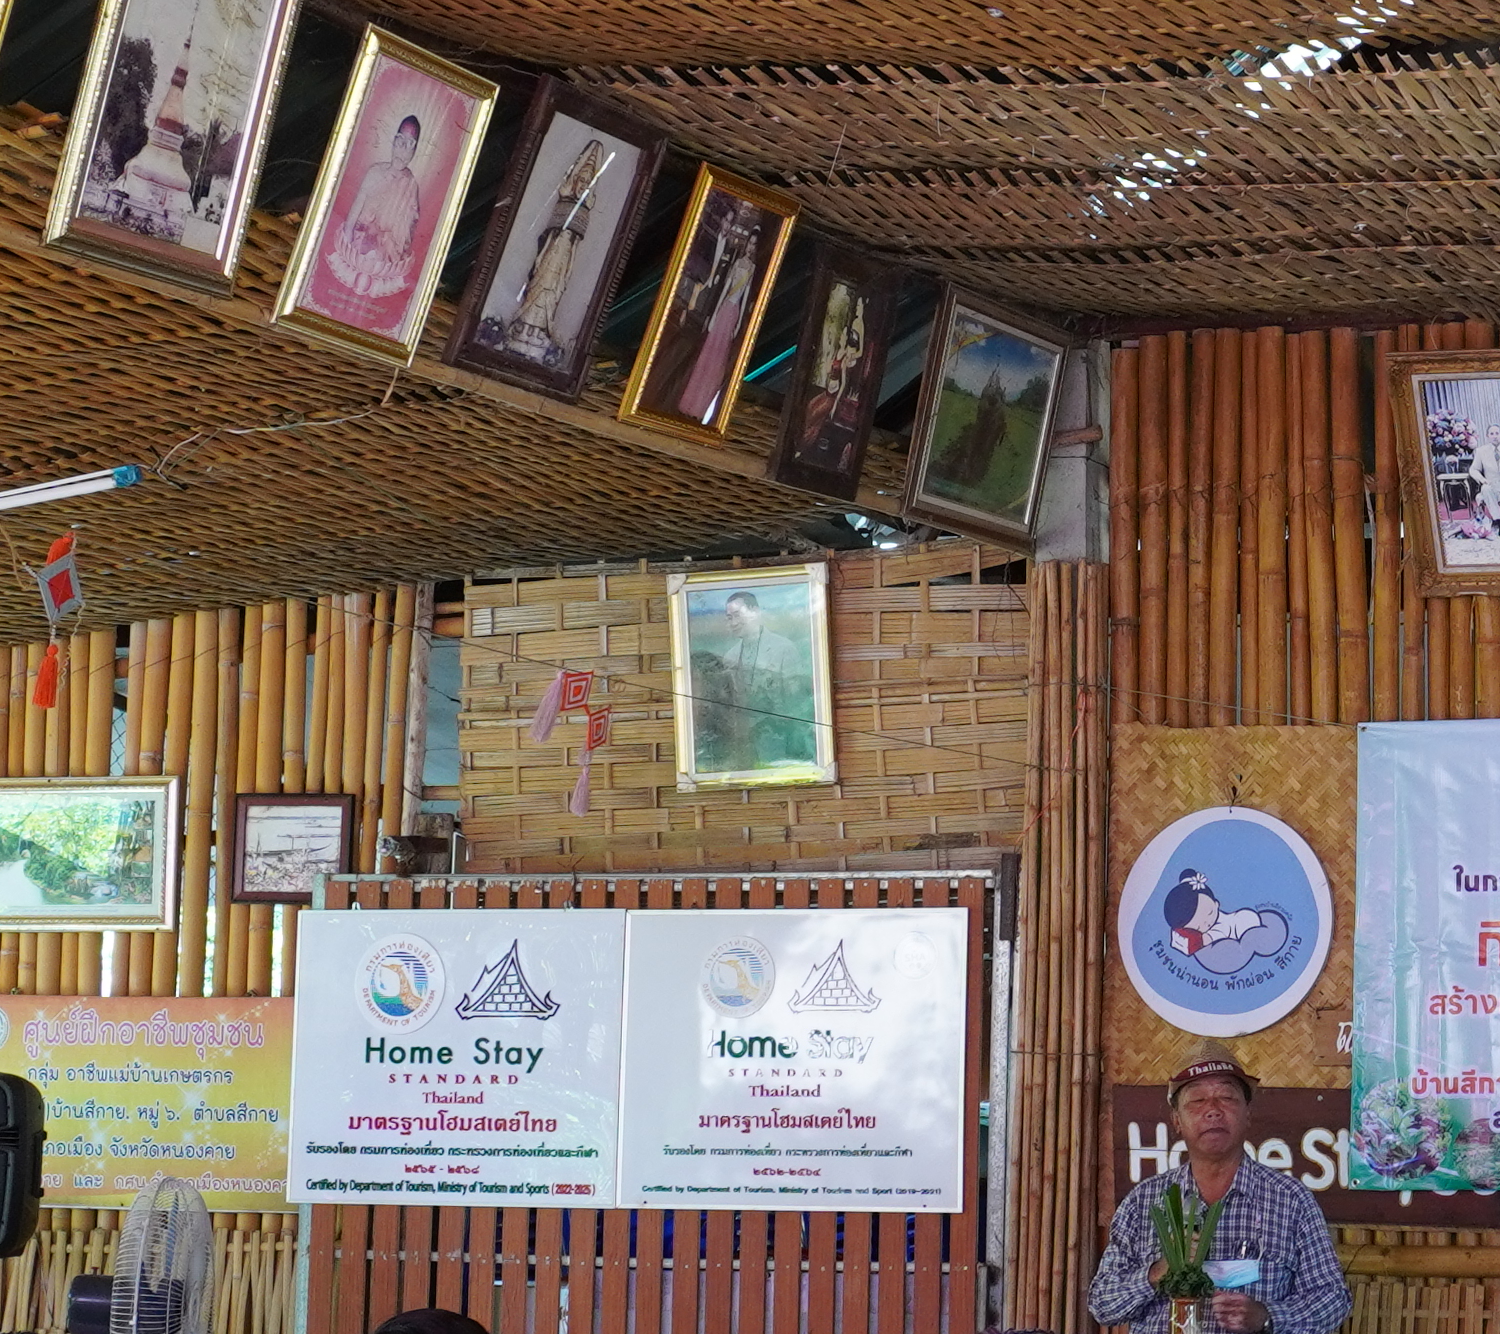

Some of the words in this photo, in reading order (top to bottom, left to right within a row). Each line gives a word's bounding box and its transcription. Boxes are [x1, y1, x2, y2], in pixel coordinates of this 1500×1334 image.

[1149, 939, 1219, 991] ชุมชนน่านอน
[1225, 971, 1275, 991] พักผ่อน
[1276, 935, 1303, 970] สีกาย
[24, 1008, 264, 1060] ศูนย์ฝึกอาชีพชุมชน
[365, 1037, 454, 1065] Home
[473, 1037, 545, 1073] Stay
[707, 1029, 798, 1059] Home
[806, 1029, 875, 1065] Stay
[28, 1063, 59, 1089] กลุ่ม
[66, 1062, 234, 1085] อาชีพแม่บ้านเกษตรกร
[389, 1073, 520, 1085] STANDARD
[728, 1067, 844, 1078] STANDARD
[422, 1091, 484, 1105] Thailand
[748, 1083, 822, 1098] Thailand
[137, 1101, 160, 1128] หมู่
[194, 1100, 279, 1123] ตำบลสีกาย
[348, 1110, 558, 1136] มาตรฐานโฮมสเตย์ไทย
[698, 1108, 877, 1134] มาตรฐานโฮมสเตย์ไทย
[110, 1136, 235, 1160] จังหวัดหนองคาย
[74, 1173, 104, 1188] และ
[306, 1179, 338, 1192] Certified
[339, 1179, 348, 1194] by
[350, 1180, 394, 1195] Department
[395, 1180, 403, 1192] of
[437, 1181, 468, 1196] Ministry
[468, 1181, 478, 1194] of
[479, 1182, 508, 1195] Tourism
[509, 1183, 523, 1195] and
[525, 1183, 550, 1197] Sports
[642, 1185, 673, 1194] Certified
[675, 1185, 685, 1195] by
[687, 1185, 730, 1196] Department
[733, 1185, 741, 1194] of
[778, 1185, 809, 1196] Ministry
[811, 1186, 820, 1195] of
